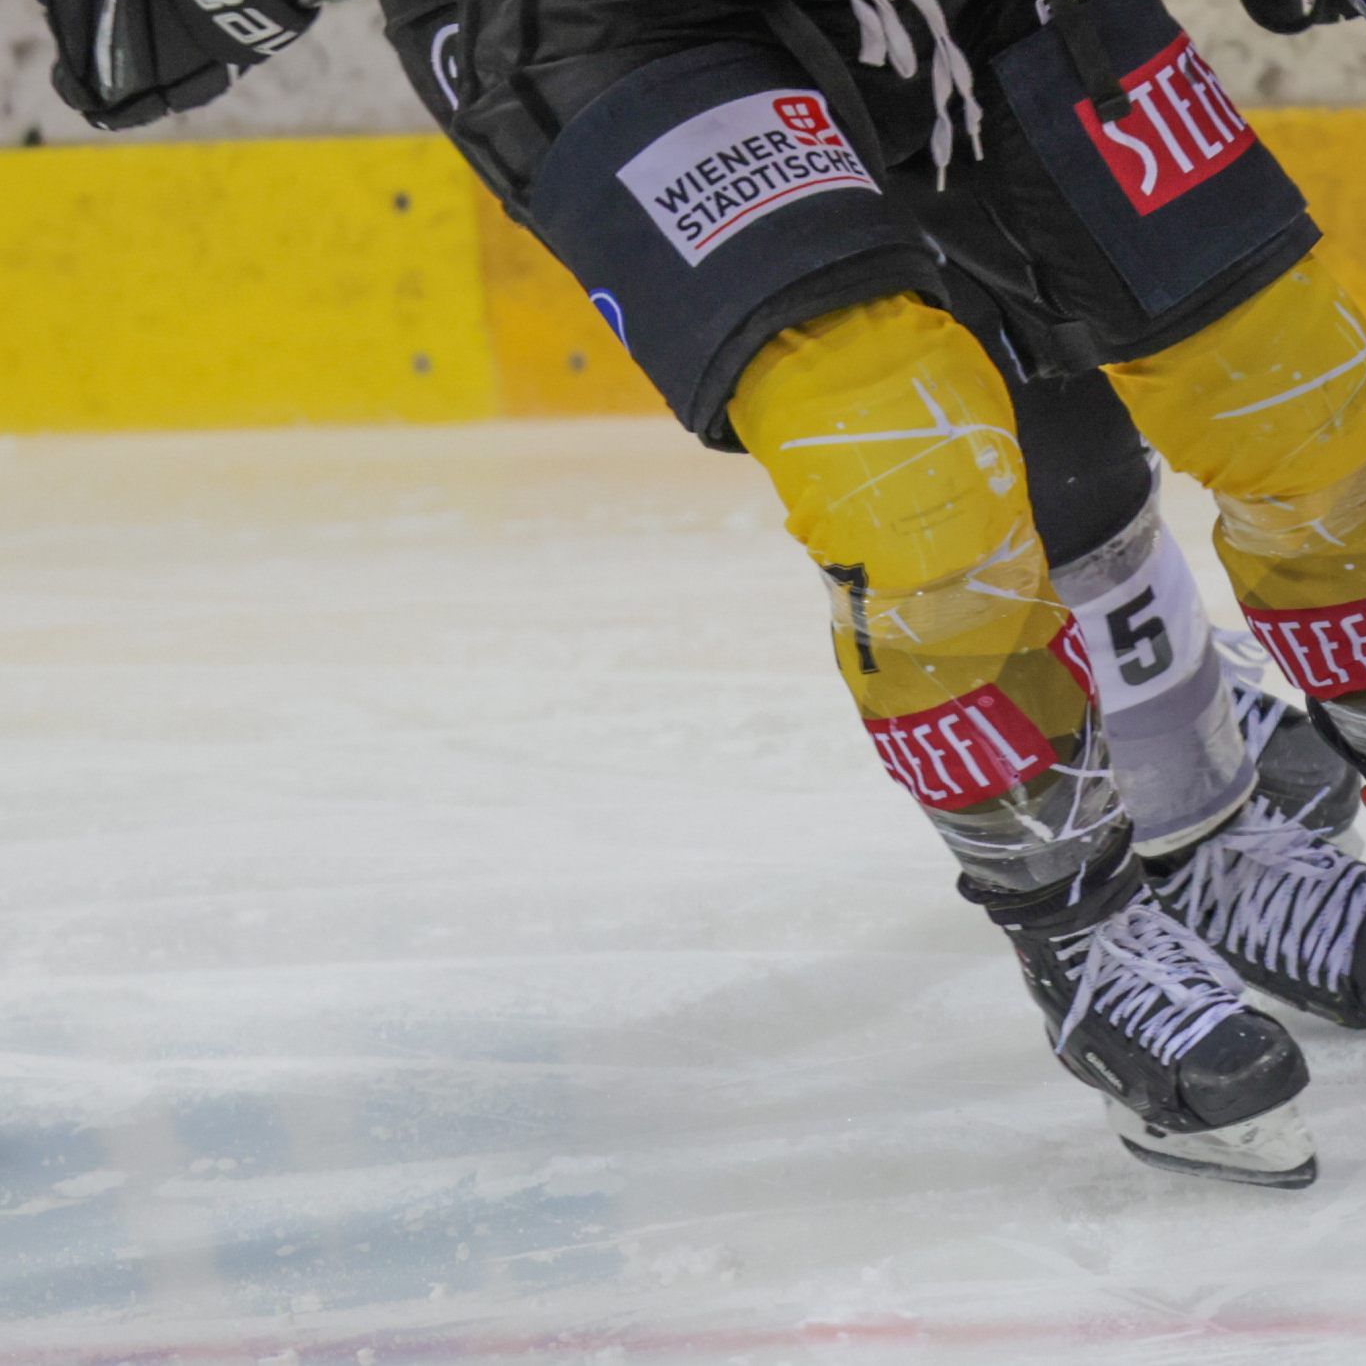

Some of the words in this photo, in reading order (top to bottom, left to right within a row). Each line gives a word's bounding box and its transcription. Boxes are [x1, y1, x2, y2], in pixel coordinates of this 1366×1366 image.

[654, 129, 797, 215] WIENER
[676, 149, 865, 241] STÄDTISCHE
[1106, 584, 1175, 687] 5
[873, 705, 1039, 802] TEFFL
